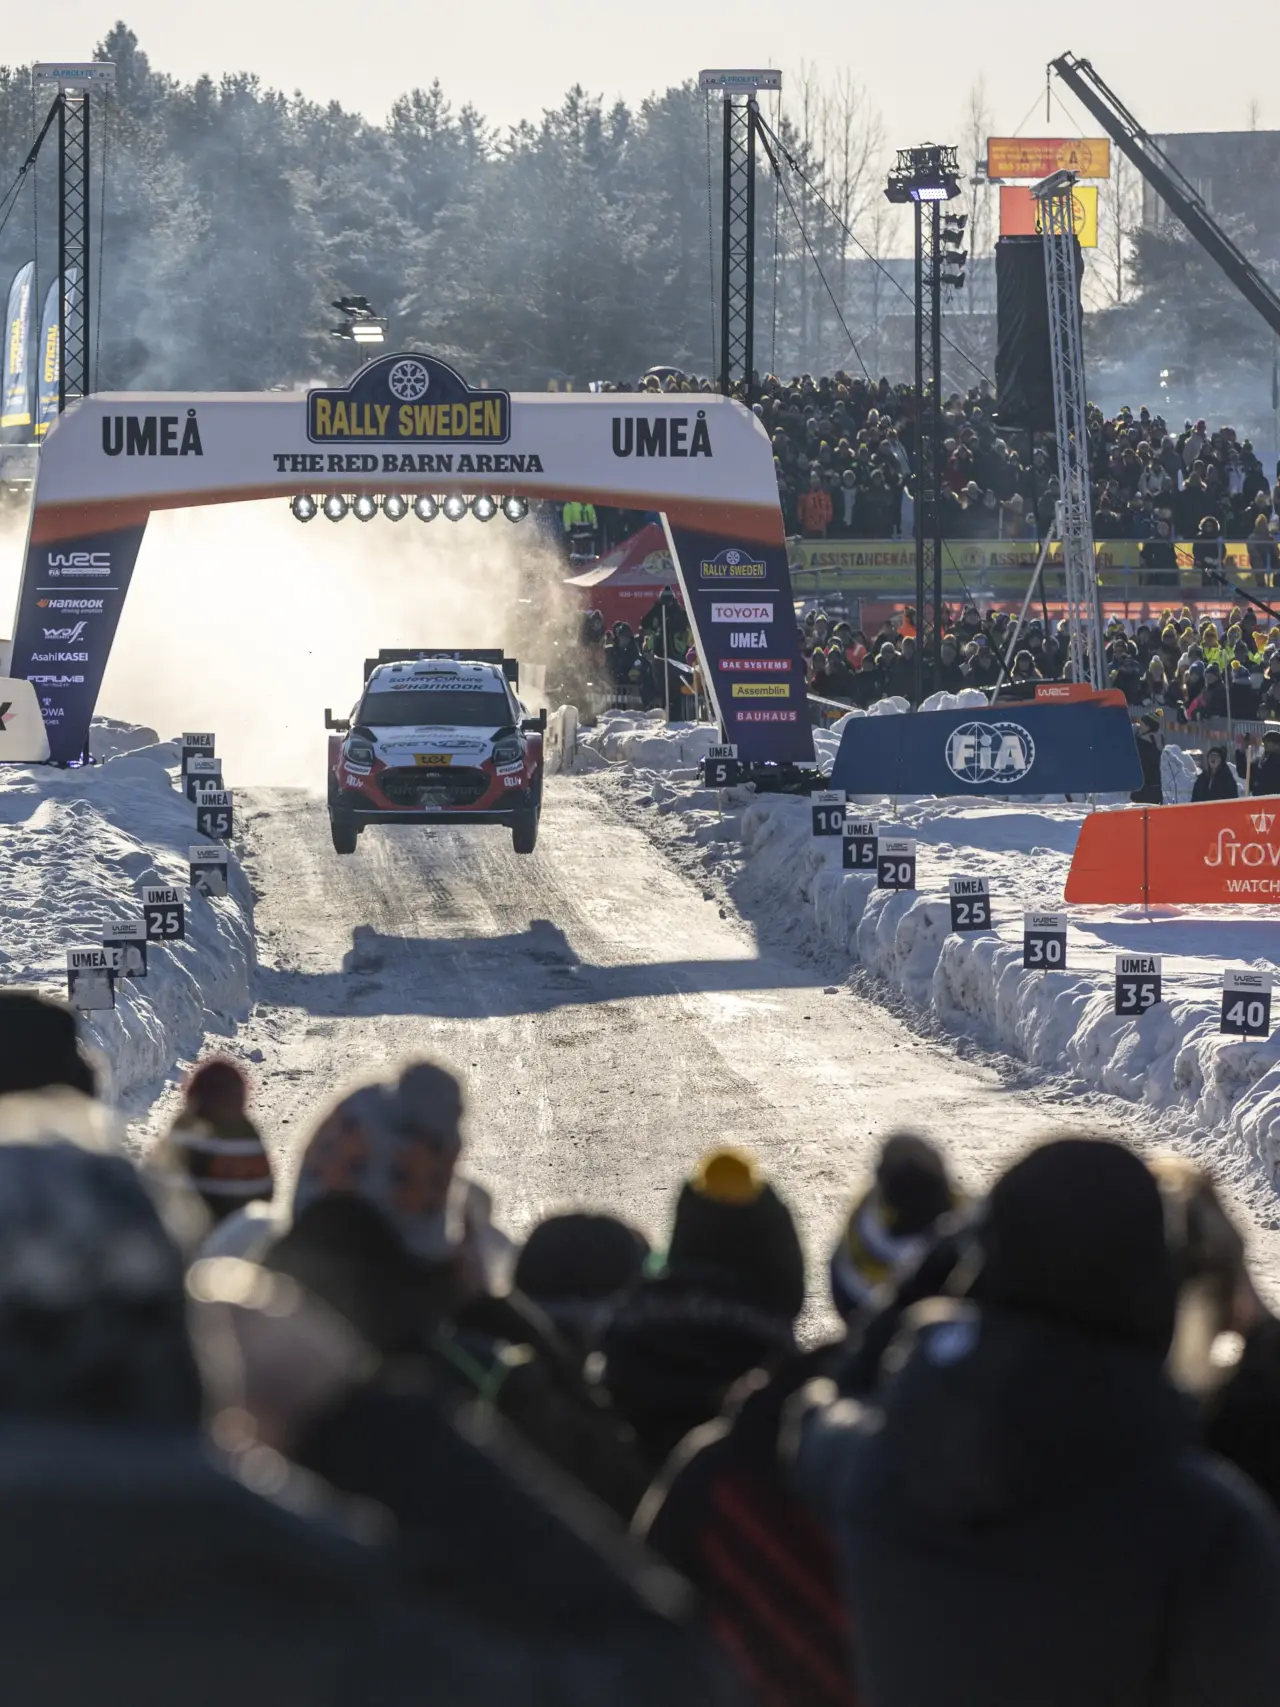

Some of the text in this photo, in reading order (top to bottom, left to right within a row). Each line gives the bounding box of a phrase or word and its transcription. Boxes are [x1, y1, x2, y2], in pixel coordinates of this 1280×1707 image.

[316, 397, 501, 437] RALLY SWEDEN
[101, 409, 203, 457] UMEÅ
[611, 409, 712, 458] UMEÅ
[273, 454, 544, 473] THE RED BARN ARENA
[48, 552, 111, 566] WRC
[703, 562, 764, 576] RALLY SWEDEN
[715, 607, 769, 618] TOYOTA
[730, 630, 767, 648] UMEÅ
[722, 660, 788, 670] BAE SYSTEMS
[737, 686, 786, 696] Assemblin
[1038, 686, 1070, 697] WRC
[737, 712, 796, 721] BAUHAUS
[187, 735, 211, 746] UMEÅ
[709, 746, 734, 758] UMEÅ
[716, 764, 726, 781] 5
[202, 793, 228, 805] UMEÅ
[203, 814, 228, 832] 15
[817, 811, 842, 829] 10
[848, 824, 873, 835] UMEÅ
[848, 844, 873, 862] 15
[883, 863, 911, 882] 20
[954, 879, 984, 894] UMEÅ
[148, 891, 178, 903] UMEÅ
[956, 903, 985, 923] 25
[149, 912, 179, 933] 25
[1029, 939, 1060, 962] 30
[72, 952, 107, 967] UMEÅ
[1122, 957, 1155, 973] UMEÅ
[1122, 984, 1155, 1007] 35
[1226, 1001, 1265, 1027] 40
